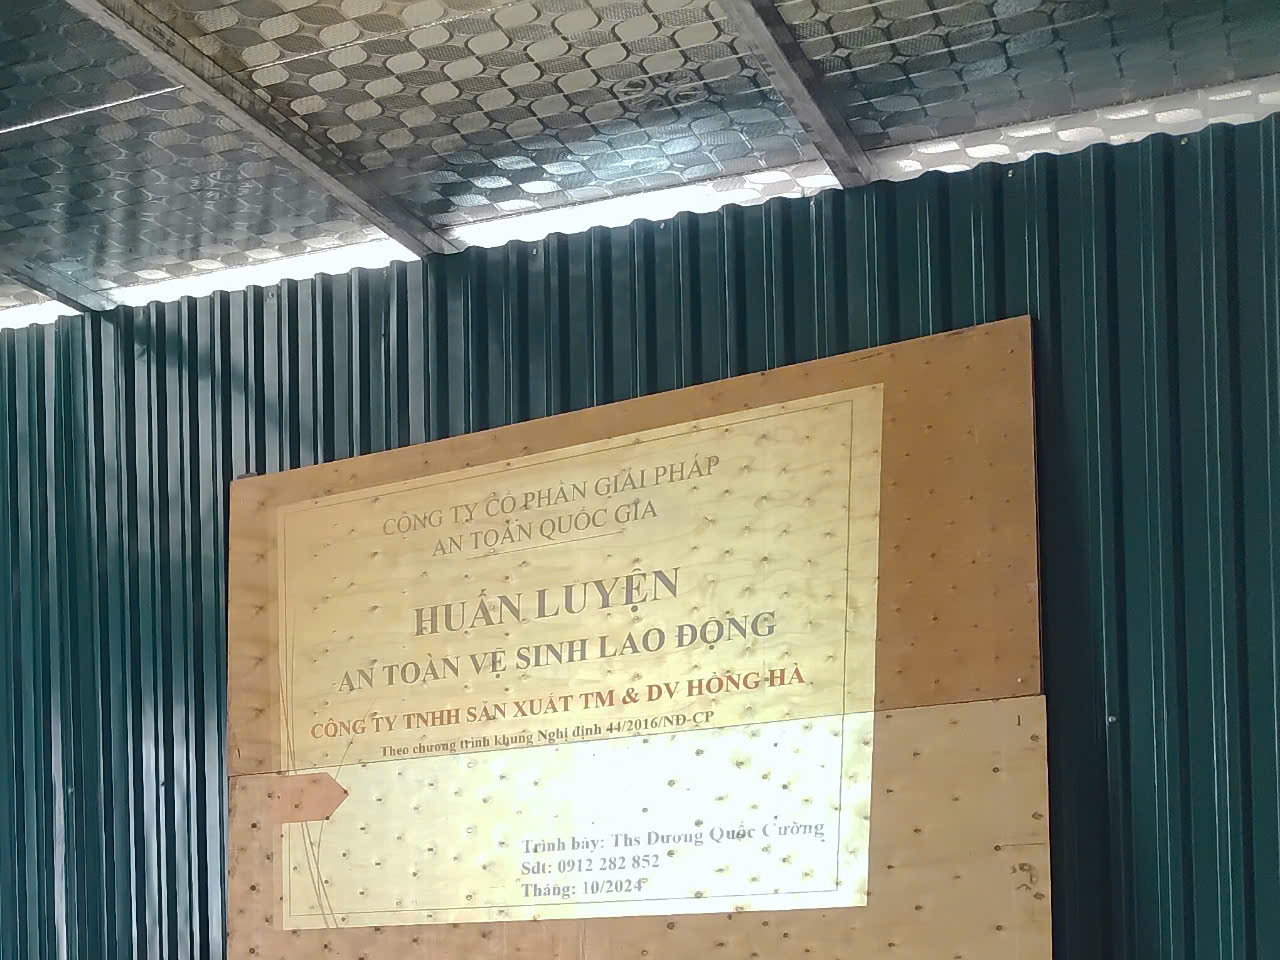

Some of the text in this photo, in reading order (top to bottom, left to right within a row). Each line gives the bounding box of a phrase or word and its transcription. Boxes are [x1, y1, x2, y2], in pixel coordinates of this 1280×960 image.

[383, 453, 720, 535] CÔNG TY CỔ PHẦN GIẢI PHÁP
[432, 500, 658, 557] AN TOÀN QUỐC GIA
[413, 567, 681, 637] HUẤN LUYỆN
[338, 610, 776, 691] AN TOÀN VỆ SINH LAO ĐỘNG
[310, 663, 805, 738] CÔNG TY TNHH SẢN XUẤT TM & DV HỒNG HÀ
[381, 744, 409, 757] Theo
[460, 736, 490, 750] trình
[494, 730, 534, 748] khung
[537, 727, 568, 744] Nghị
[605, 710, 715, 734] 44/2016/NĐ-CP
[522, 837, 566, 853] Trình
[611, 833, 641, 848] Ths
[647, 830, 704, 847] Dương
[709, 821, 756, 844] Quốc
[557, 858, 593, 873] 0912
[599, 856, 626, 871] 282
[631, 854, 660, 868] 852
[521, 878, 643, 899] Tháng: 10/2024
